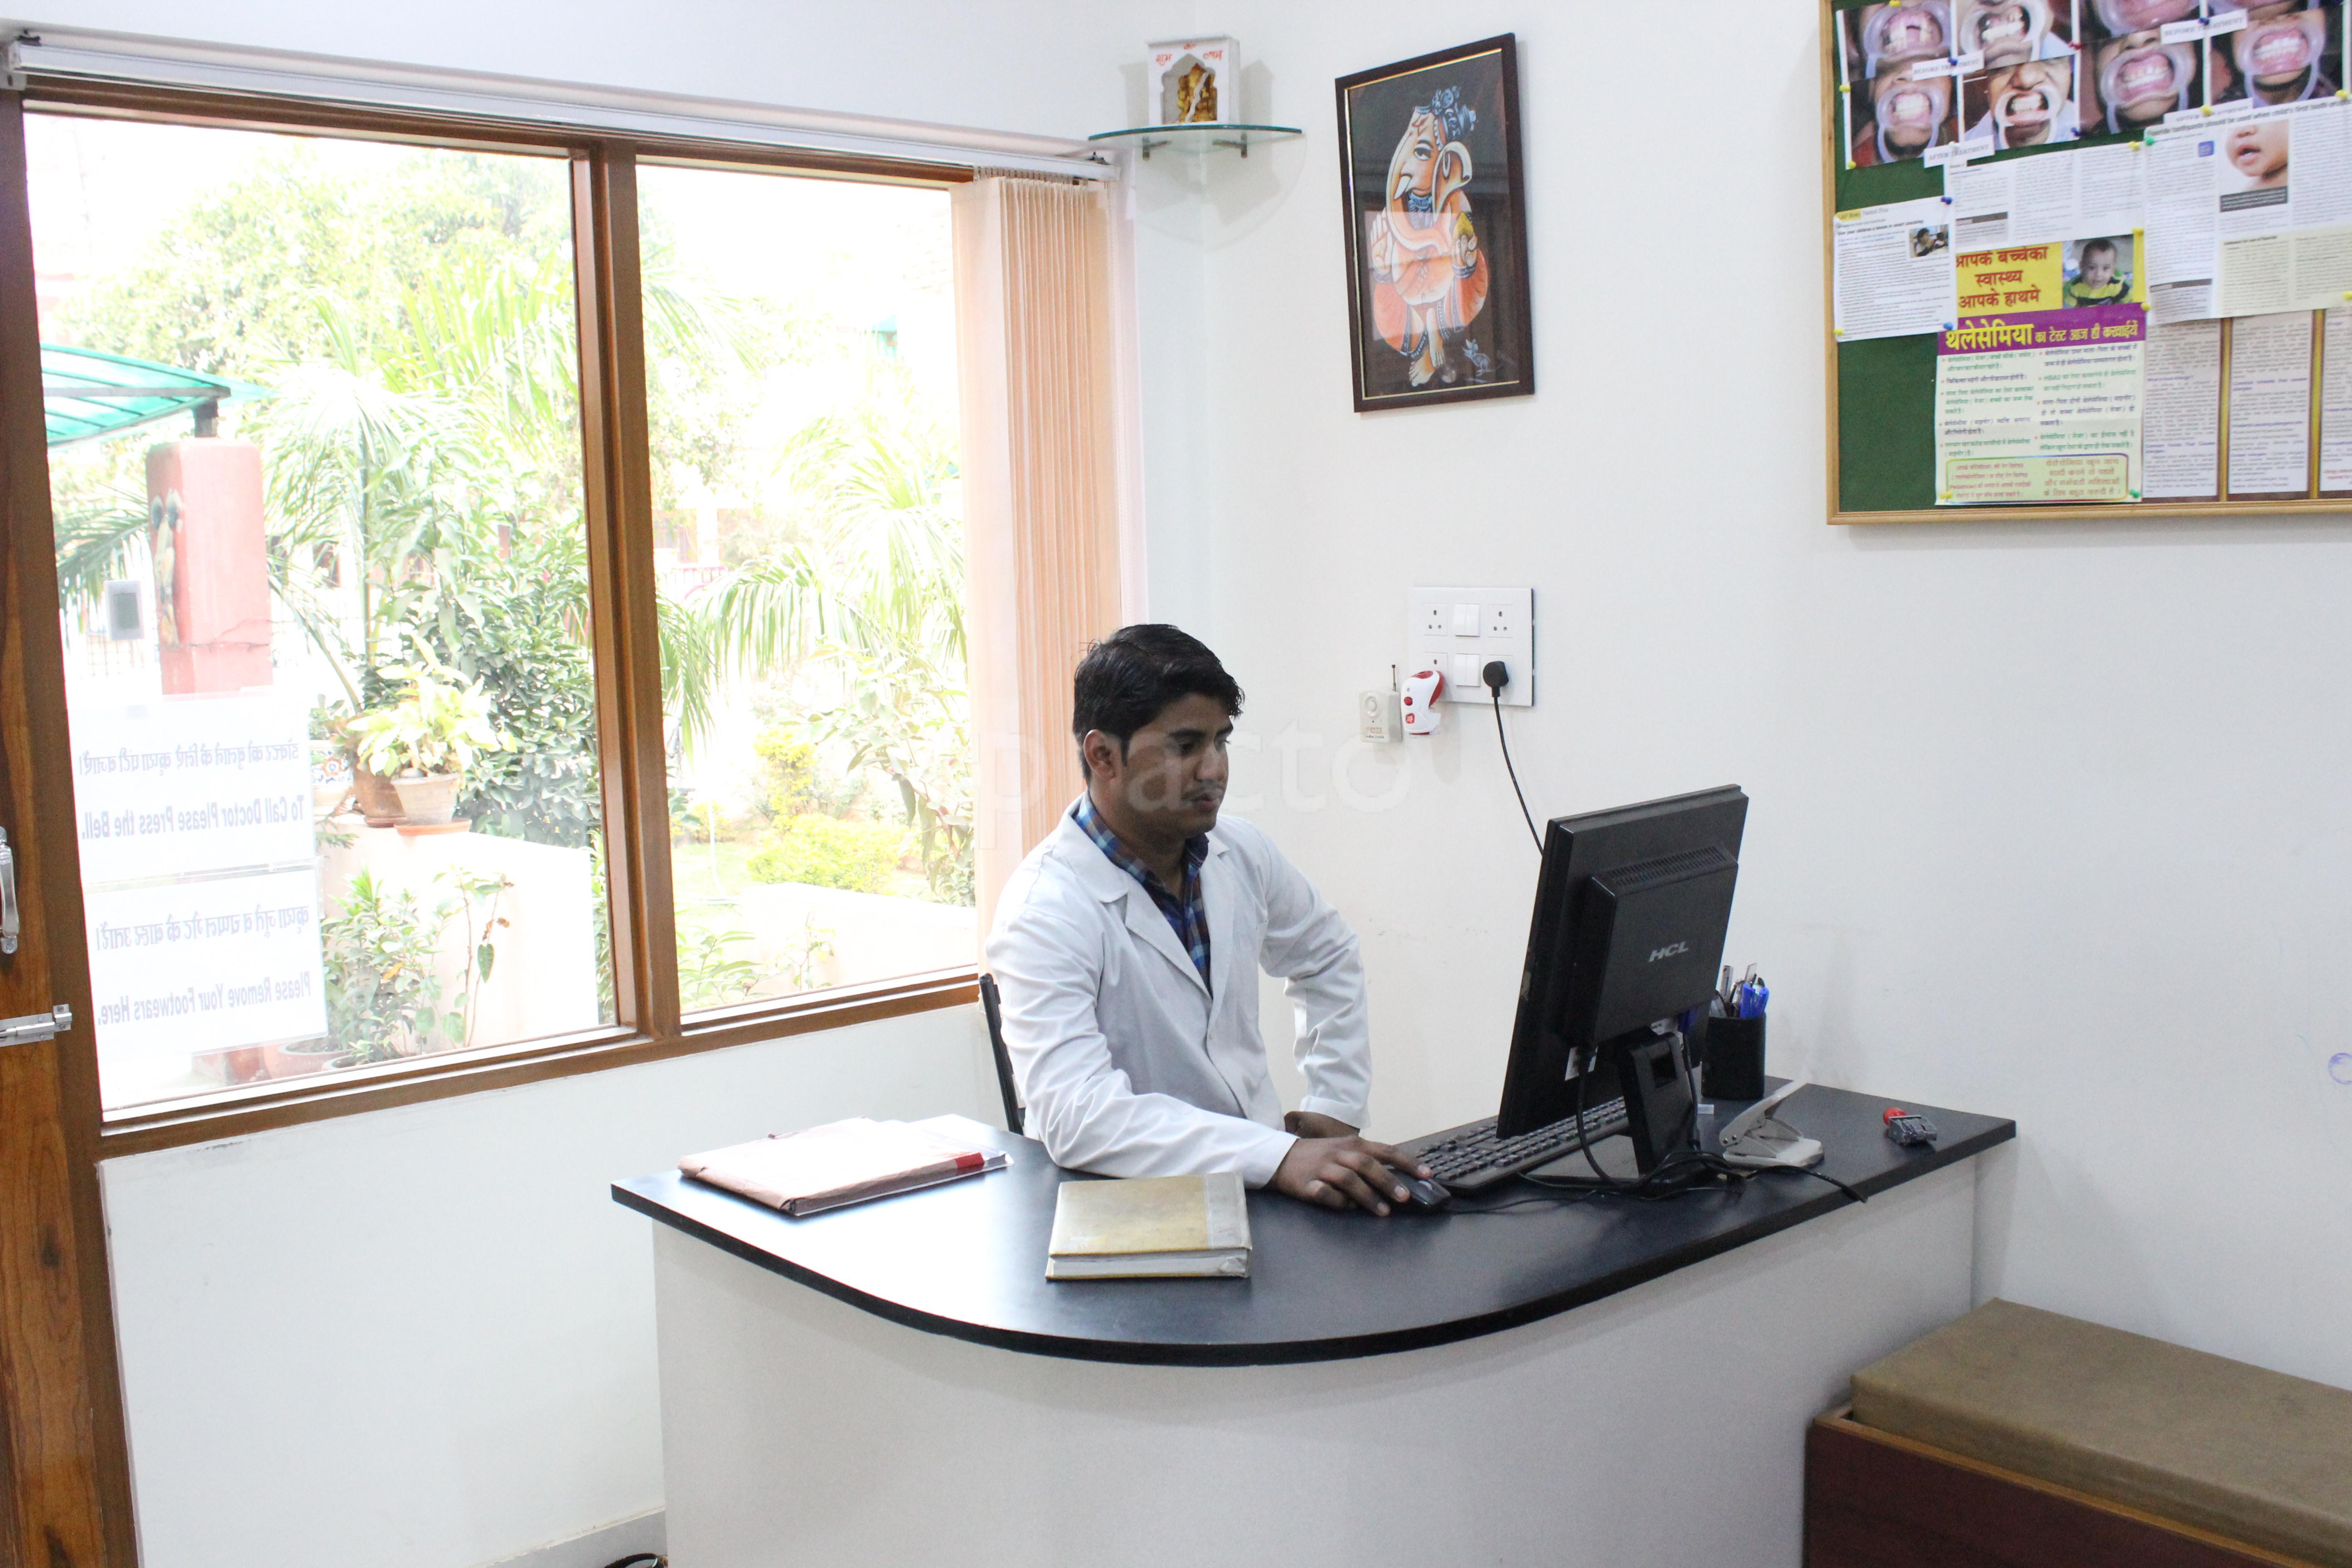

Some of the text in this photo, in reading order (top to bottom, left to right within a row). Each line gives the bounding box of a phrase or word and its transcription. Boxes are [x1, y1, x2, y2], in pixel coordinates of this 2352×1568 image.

[1959, 288, 1999, 309] आपके
[2035, 331, 2046, 343] का
[2069, 328, 2089, 341] आज
[2090, 323, 2101, 339] ही
[1648, 941, 1689, 963] HCL
